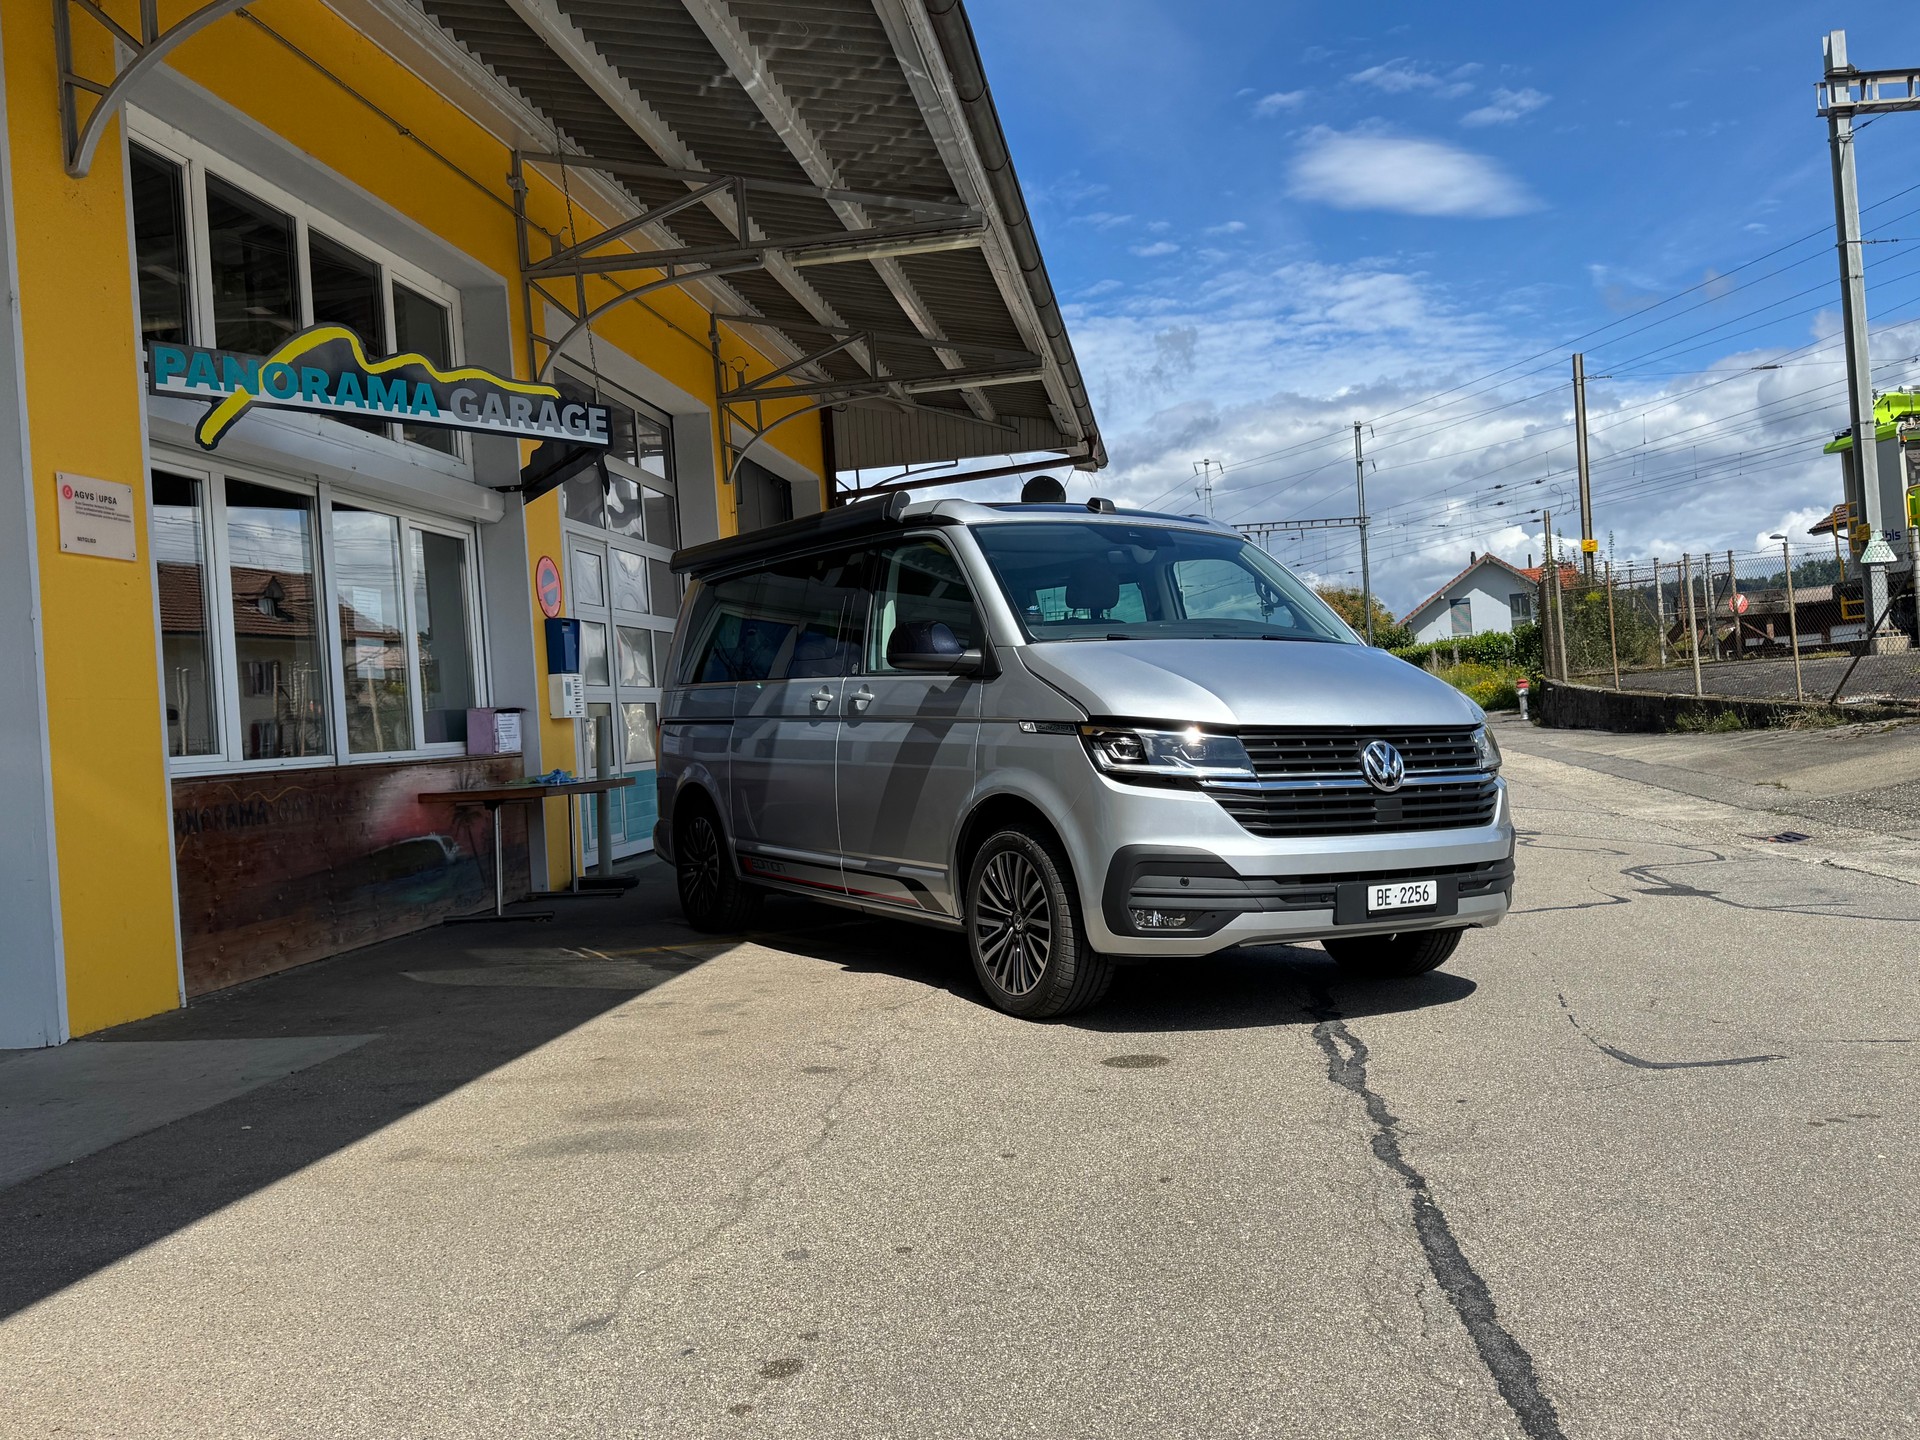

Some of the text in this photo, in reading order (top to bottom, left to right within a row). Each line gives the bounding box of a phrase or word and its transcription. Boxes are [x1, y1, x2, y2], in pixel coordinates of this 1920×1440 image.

[155, 345, 609, 440] PANORAMA GARAGE
[74, 490, 118, 505] AGVS UPSA
[1884, 528, 1901, 542] bls
